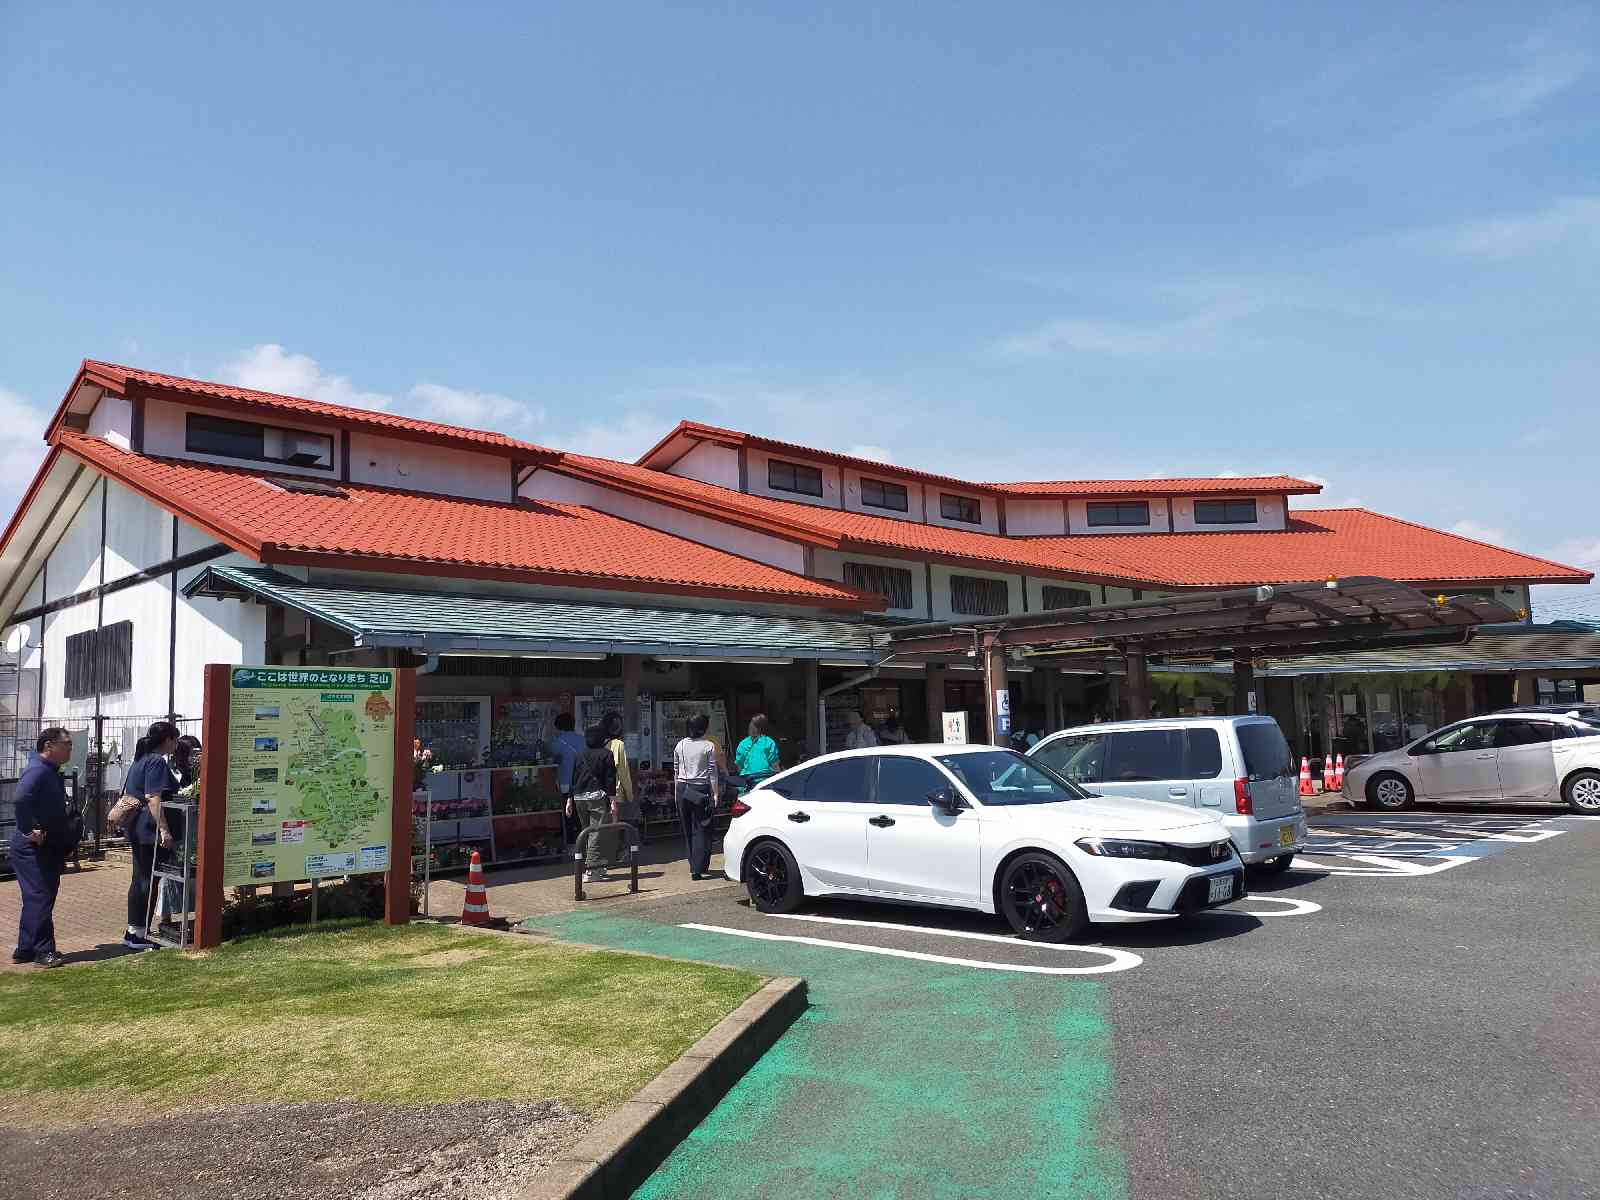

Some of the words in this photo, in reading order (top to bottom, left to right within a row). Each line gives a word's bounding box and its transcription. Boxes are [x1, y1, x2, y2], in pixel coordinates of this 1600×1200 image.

[257, 671, 366, 683] ここは世界のとなりまち
[369, 673, 389, 684] 芝山
